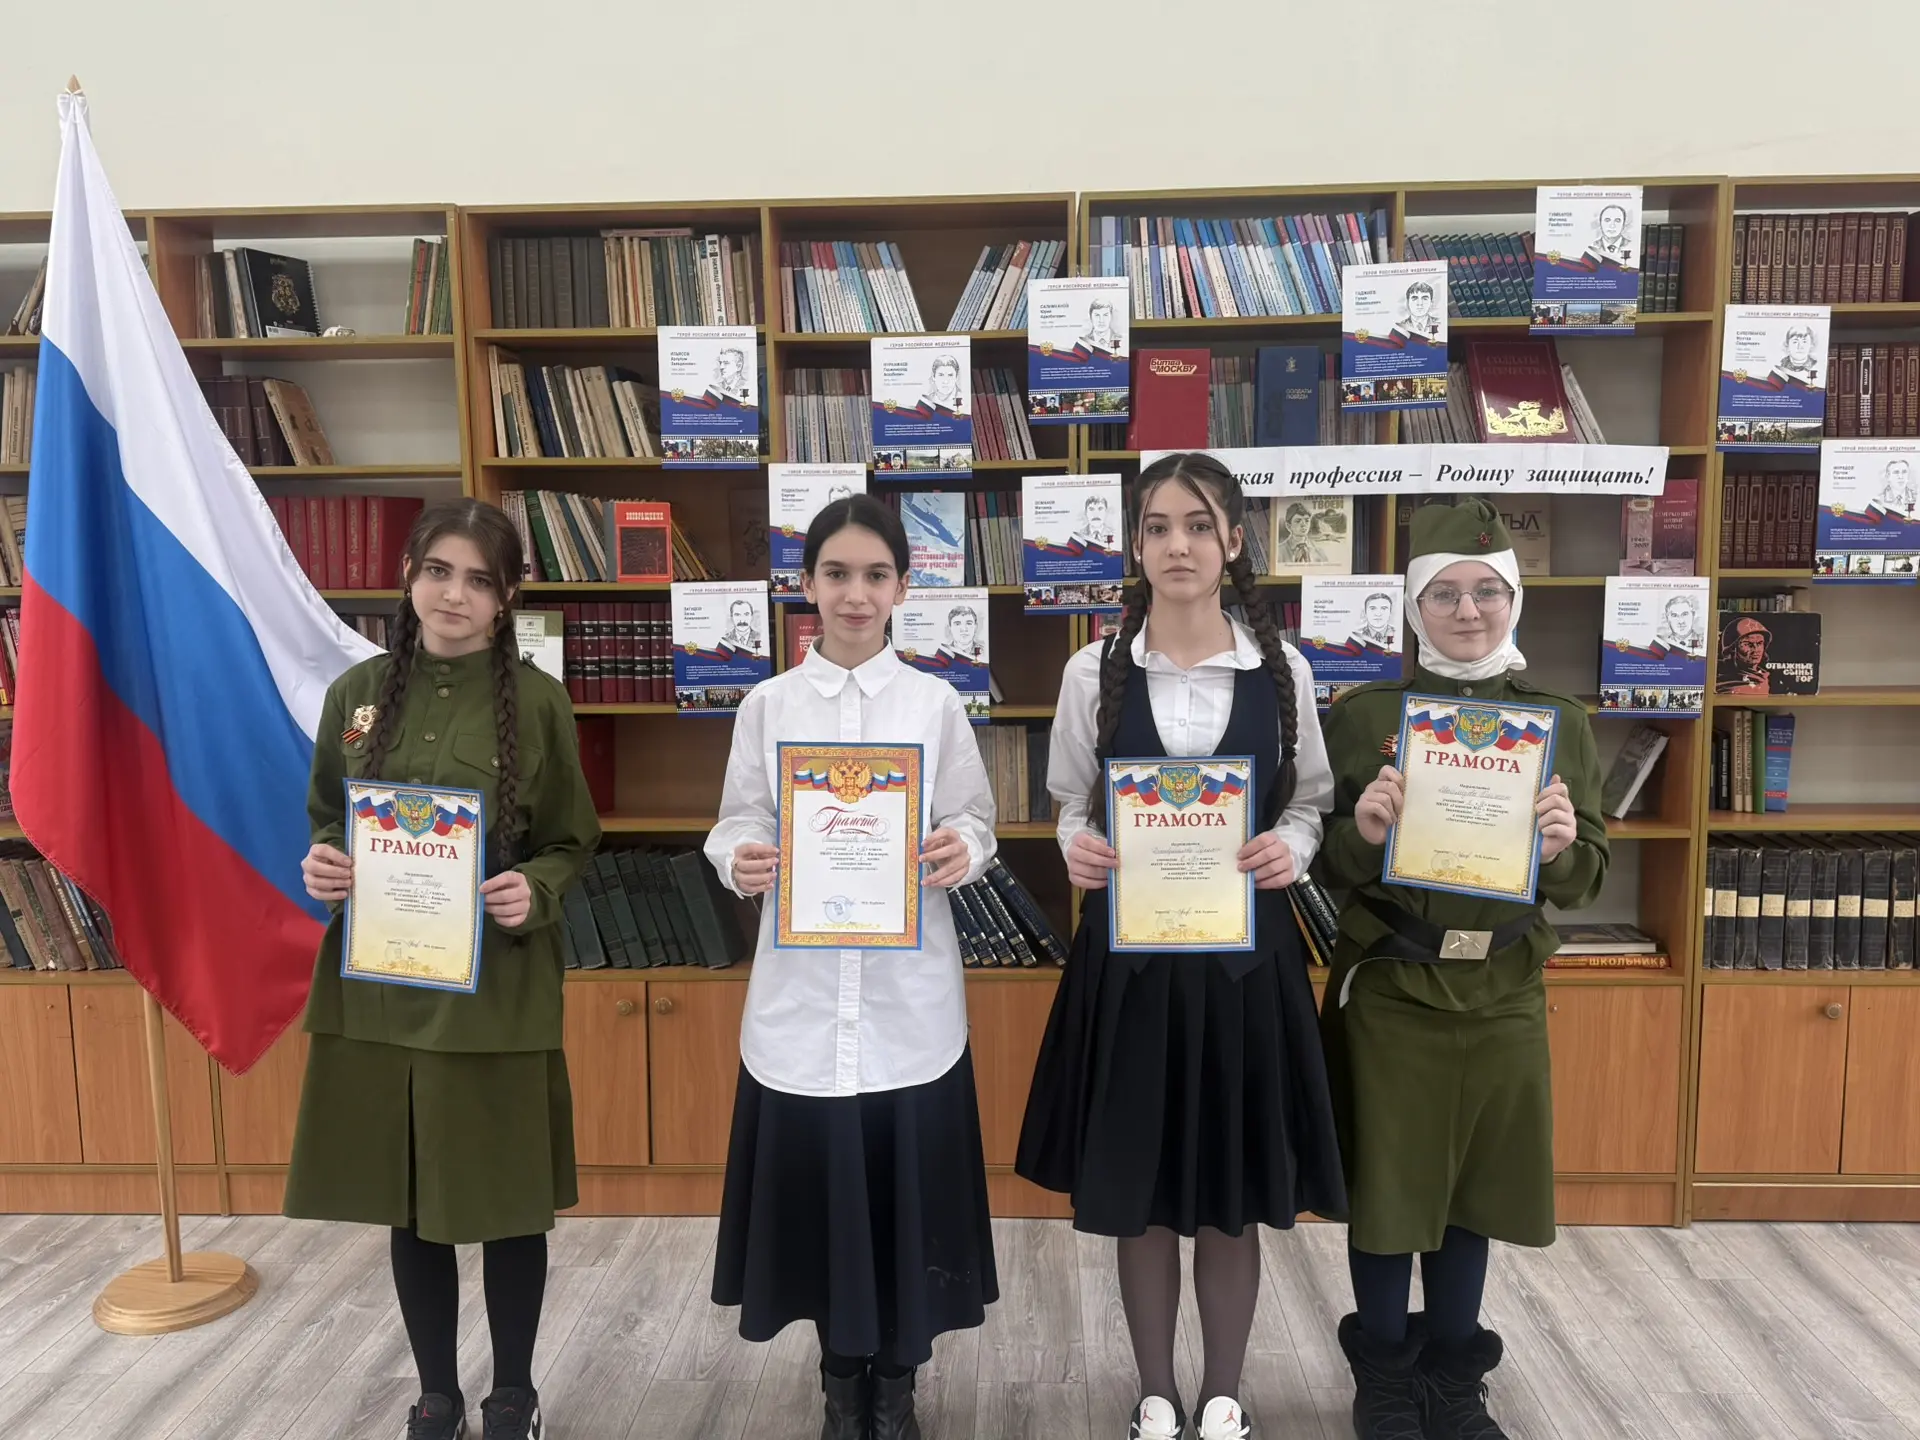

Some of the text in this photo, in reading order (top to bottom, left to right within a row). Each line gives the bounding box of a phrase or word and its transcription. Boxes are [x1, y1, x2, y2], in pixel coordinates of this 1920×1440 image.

[1151, 358, 1182, 366] Битва
[1156, 365, 1195, 373] МОСКВУ
[1233, 471, 1275, 485] кая
[1289, 466, 1403, 488] профессия
[1436, 464, 1515, 486] Родину
[1526, 467, 1654, 486] защищать!
[1500, 514, 1540, 530] ТЫЛ
[1424, 750, 1521, 774] ГРАМОТА
[811, 806, 886, 836] Грамота
[1134, 812, 1228, 828] ГРАМОТА
[370, 838, 459, 860] ГРАМОТА
[1589, 957, 1667, 968] ШКОЛЬНИКА
